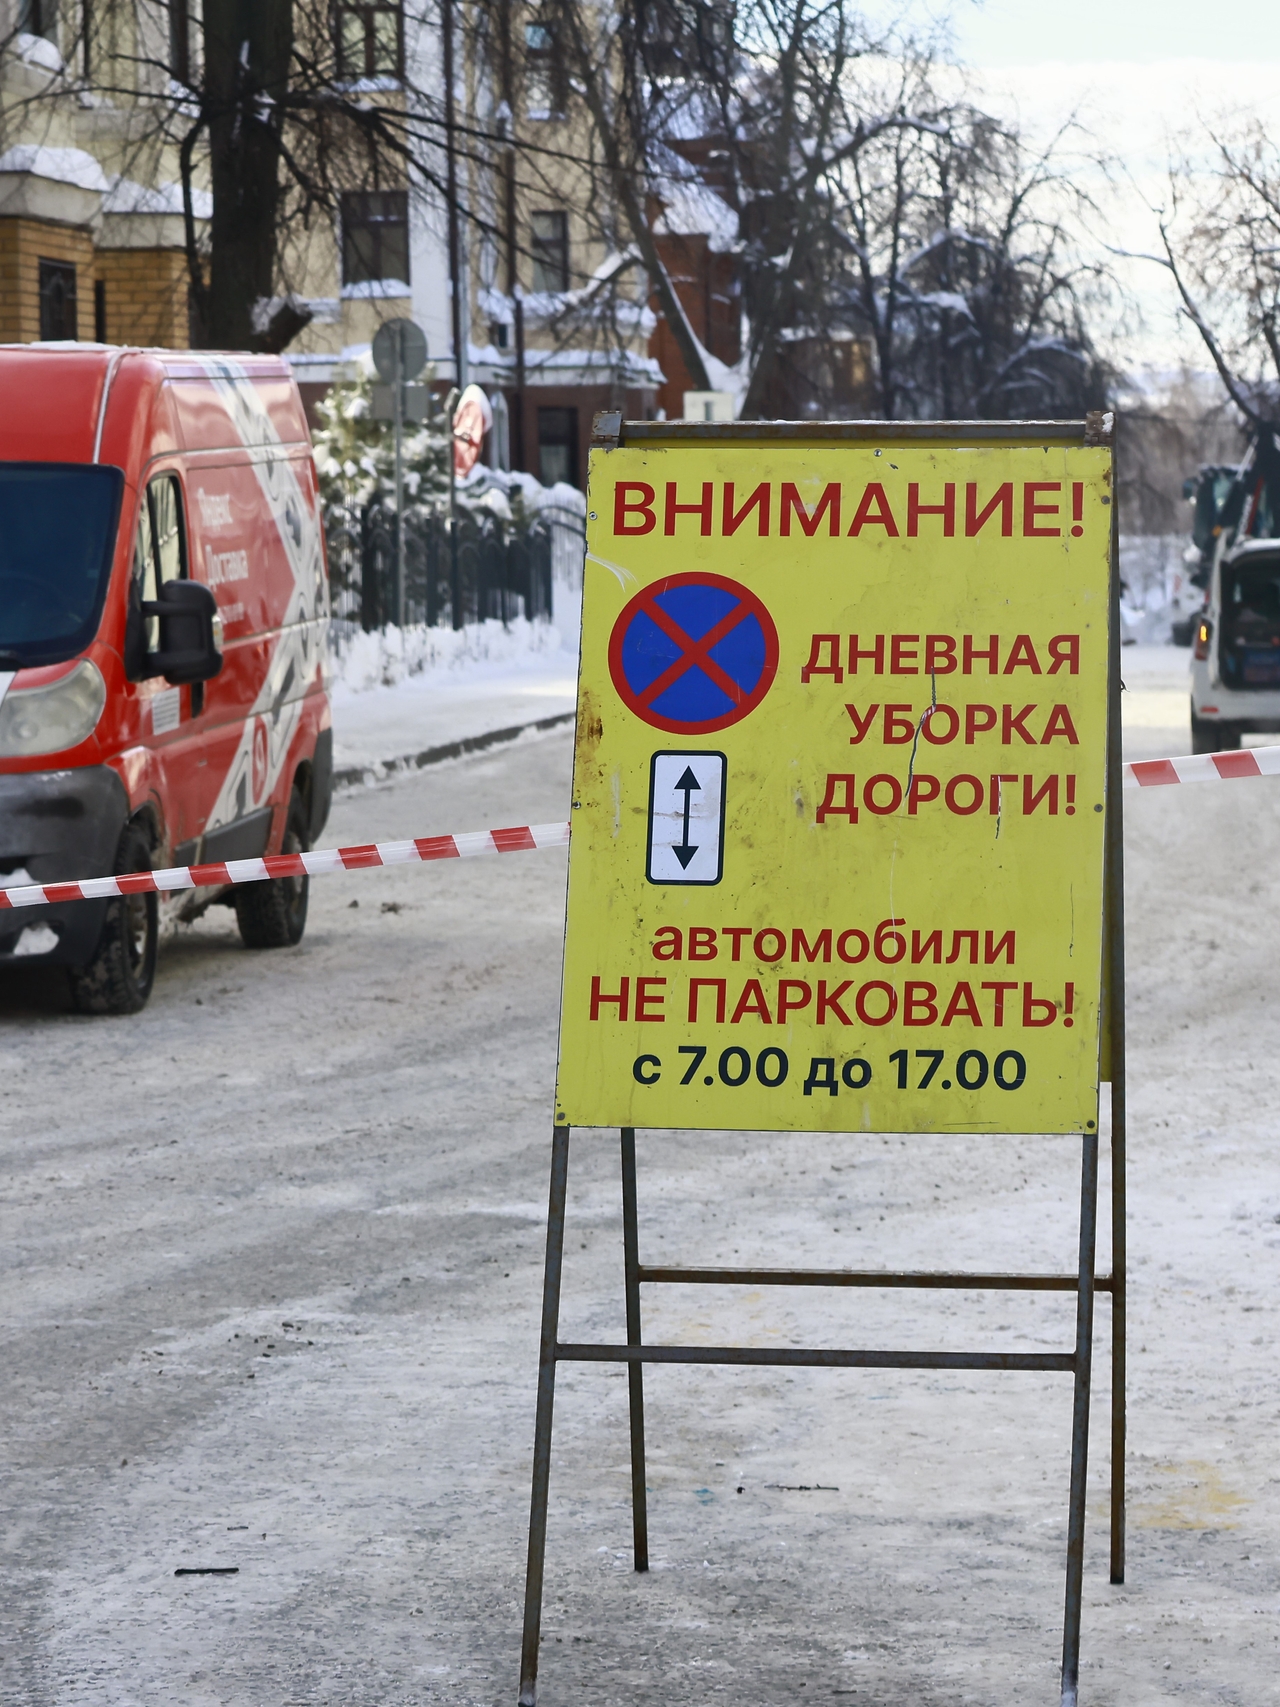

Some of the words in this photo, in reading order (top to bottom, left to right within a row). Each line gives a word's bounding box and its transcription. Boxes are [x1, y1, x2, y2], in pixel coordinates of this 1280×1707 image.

[613, 481, 1084, 538] ВНИМАНИЕ!
[800, 634, 1080, 684] ДНЕВНАЯ
[845, 703, 1080, 746] УБОРКА
[815, 773, 1076, 825] ДОРОГИ!
[652, 918, 1016, 965] автомобили
[589, 975, 667, 1023] НЕ
[687, 977, 1075, 1028] ПАРКОВАТЬ!
[632, 1054, 662, 1085] с
[678, 1045, 789, 1088] 7.00
[803, 1057, 872, 1097] до
[889, 1049, 1027, 1091] 17.00
